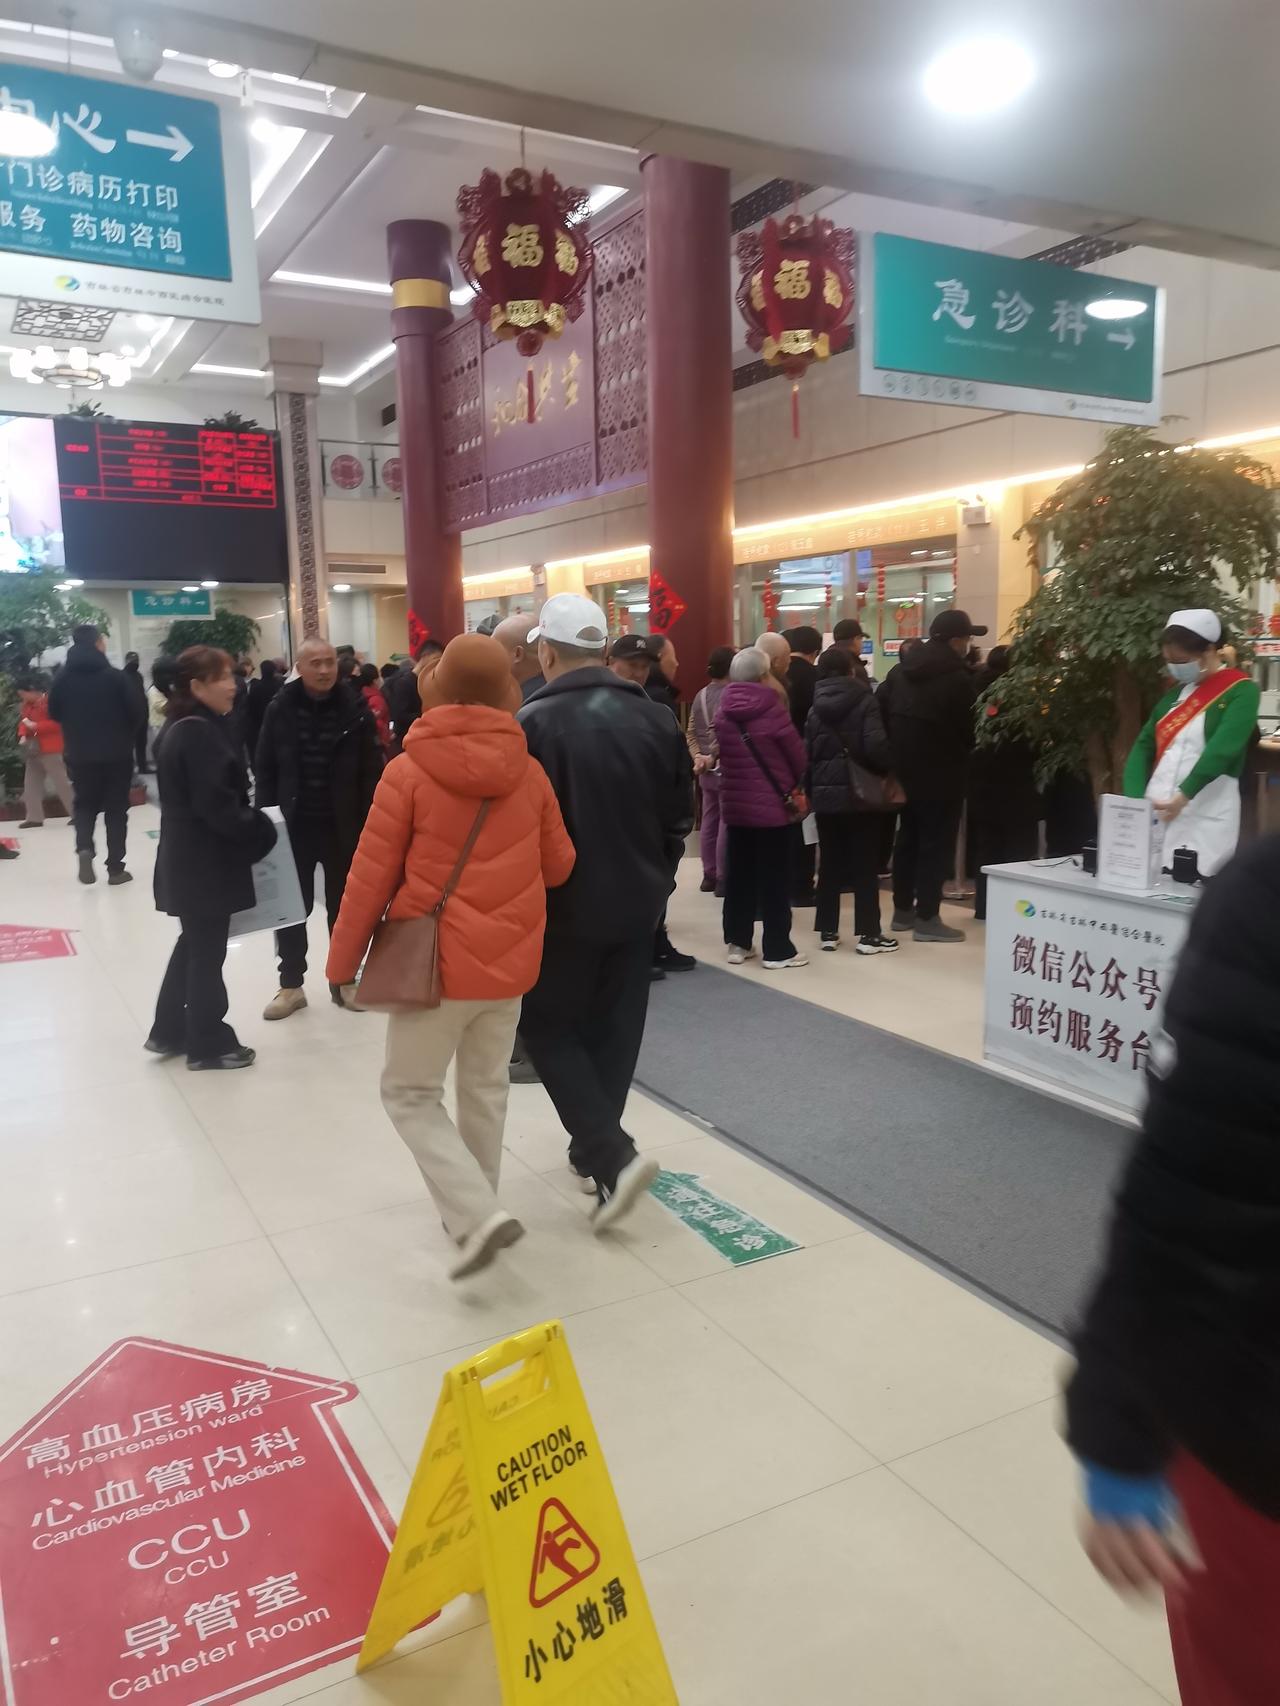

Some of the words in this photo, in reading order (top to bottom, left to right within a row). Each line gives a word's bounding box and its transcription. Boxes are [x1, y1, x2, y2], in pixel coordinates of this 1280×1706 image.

[0, 159, 180, 211] 门诊病历打印
[70, 212, 183, 254] 药物咨询
[501, 222, 544, 268] 福
[774, 259, 812, 300] 福
[931, 278, 1089, 346] 急诊科
[1011, 932, 1163, 1011] 微信公众号
[1010, 992, 1152, 1071] 预约服务台
[22, 1378, 273, 1469] 高血压病房
[45, 1423, 203, 1479] Hypertension
[208, 1403, 264, 1430] ward
[497, 1425, 573, 1483] CAUTION
[31, 1426, 300, 1528] 心血管内科
[32, 1485, 205, 1551] Cardiovascular
[210, 1453, 306, 1494] Medicine
[490, 1475, 529, 1512] WET
[534, 1440, 588, 1487] FLOOR
[128, 1508, 251, 1571] CCU
[164, 1550, 230, 1585] CCU
[120, 1571, 308, 1660] 导管室
[525, 1577, 628, 1684] 小心地滑
[108, 1640, 237, 1701] Catheter
[245, 1606, 331, 1650] Room
